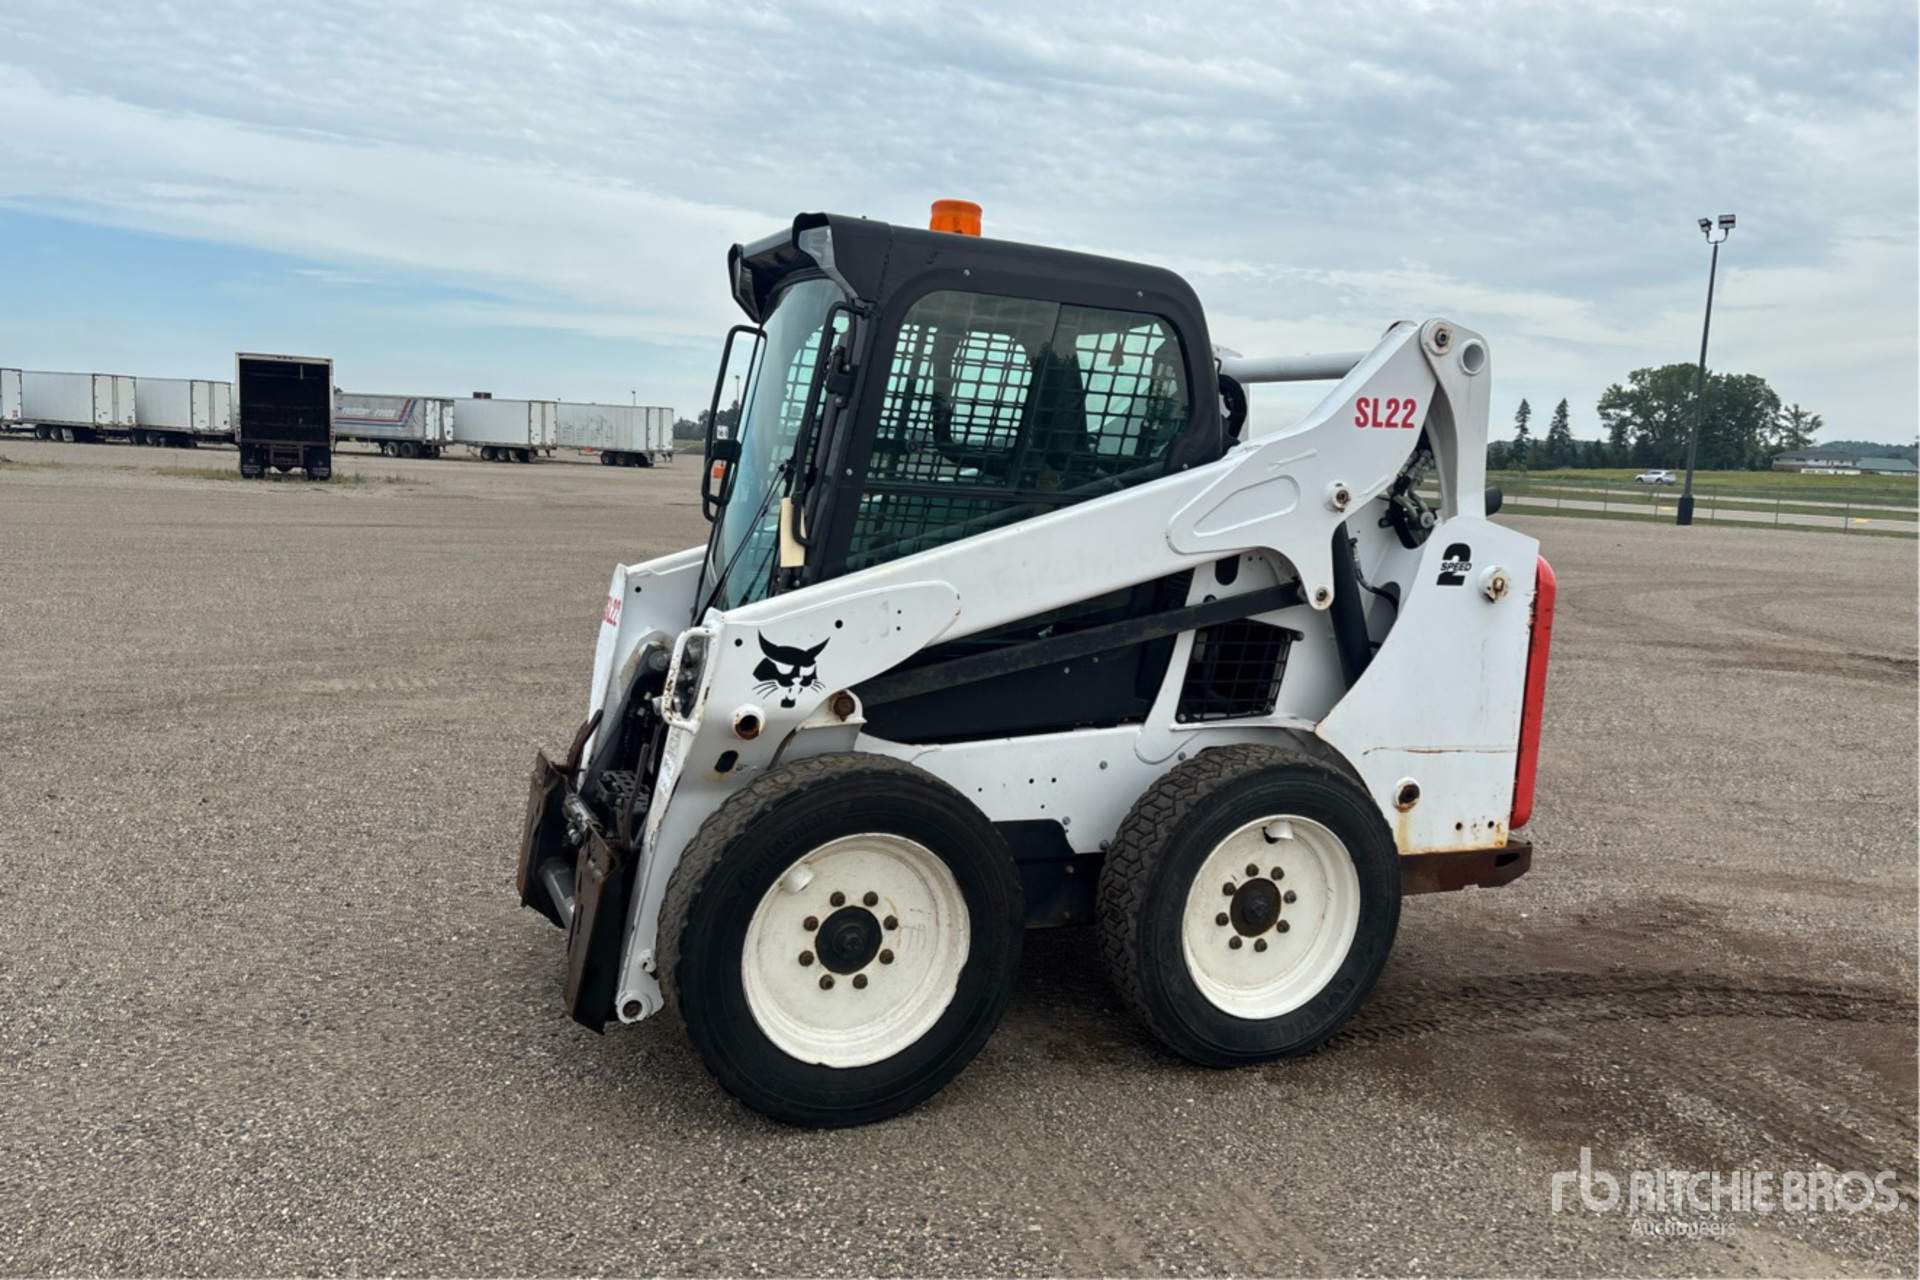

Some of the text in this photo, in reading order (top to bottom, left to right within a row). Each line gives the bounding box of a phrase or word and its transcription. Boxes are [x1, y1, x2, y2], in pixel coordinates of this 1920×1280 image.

[1354, 397, 1417, 428] SL22
[1436, 542, 1472, 586] 2
[1440, 561, 1473, 572] SPEED
